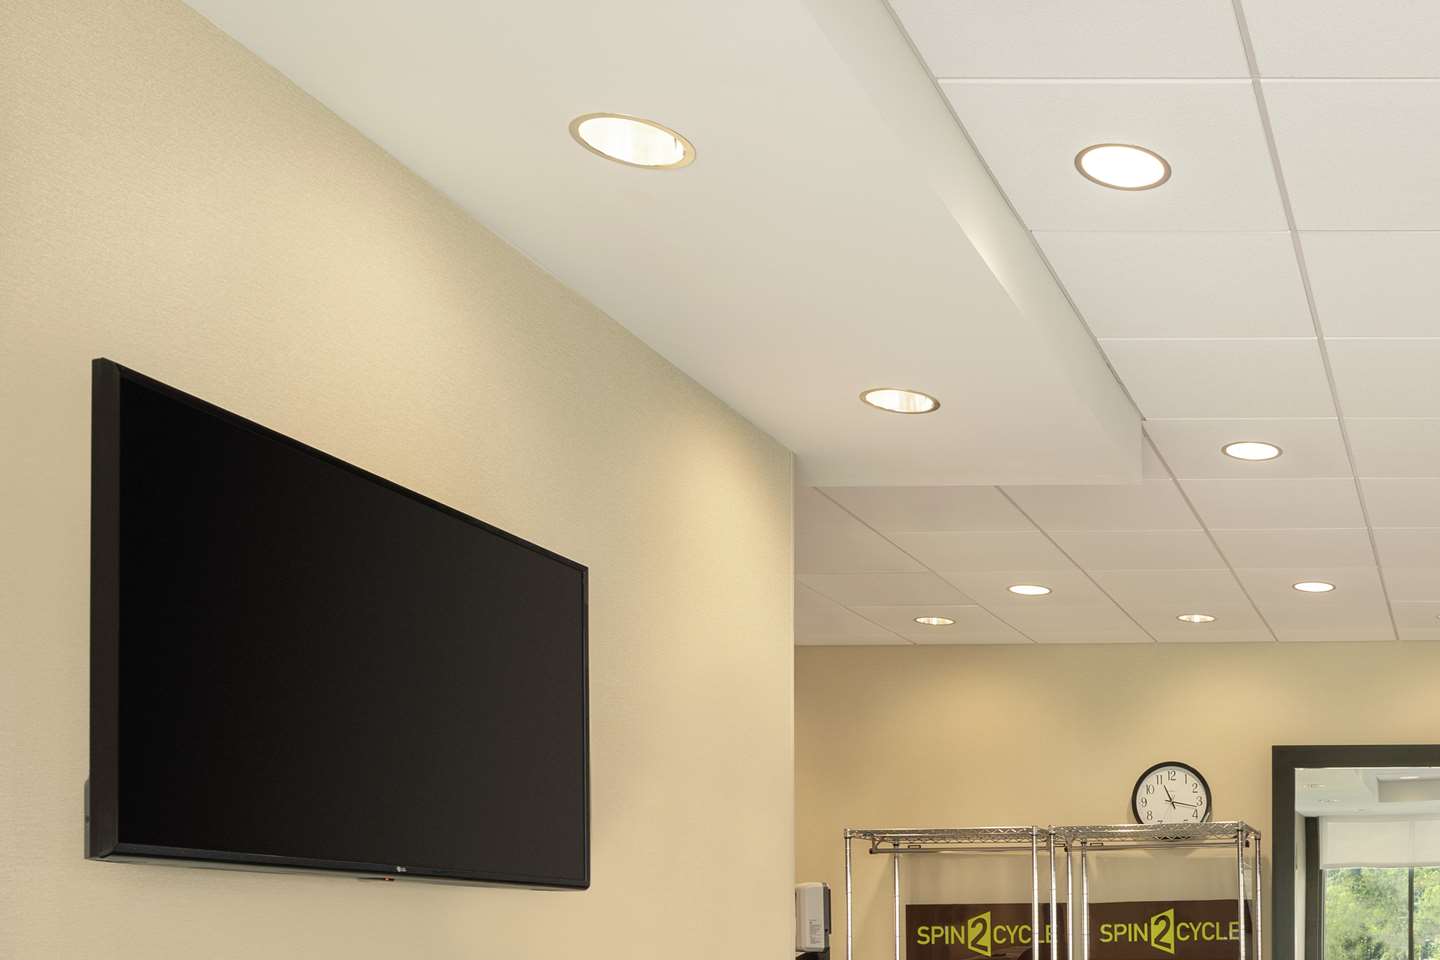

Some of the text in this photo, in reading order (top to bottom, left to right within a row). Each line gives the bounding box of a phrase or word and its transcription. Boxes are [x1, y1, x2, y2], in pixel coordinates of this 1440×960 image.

[1156, 774, 1163, 785] 11
[1167, 770, 1177, 781] 12
[1145, 784, 1155, 795] 10
[1192, 783, 1198, 794] 2
[1140, 797, 1148, 808] 9
[1196, 796, 1203, 807] 3
[1146, 810, 1153, 821] 8
[1192, 809, 1199, 819] 4
